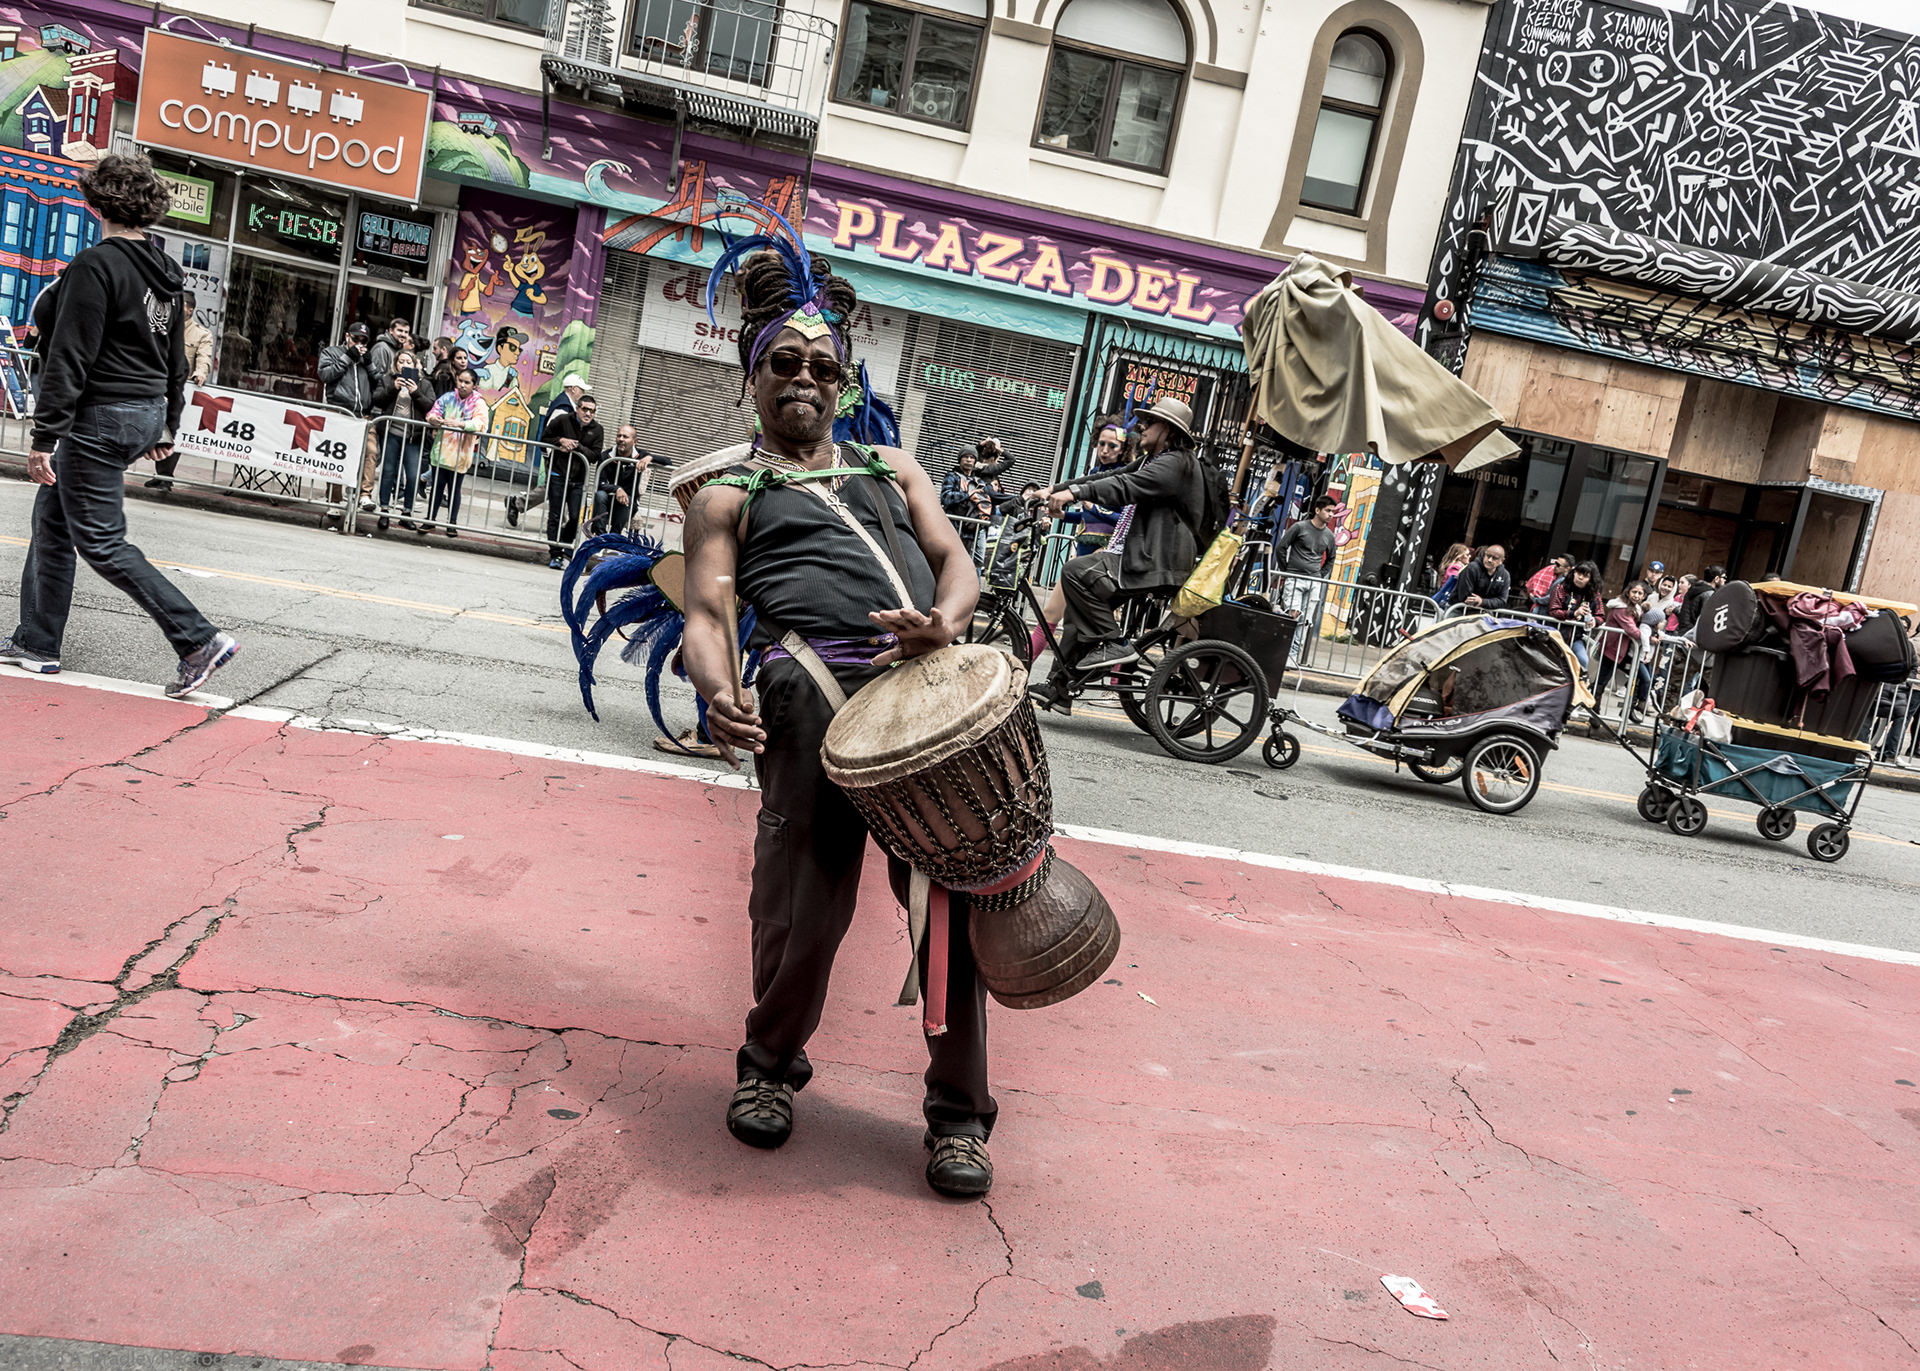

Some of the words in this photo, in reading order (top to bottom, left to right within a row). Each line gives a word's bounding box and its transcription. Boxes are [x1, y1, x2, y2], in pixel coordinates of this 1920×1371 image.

[1525, 10, 1576, 31] KEETON
[1601, 11, 1669, 40] STANDING
[1520, 23, 1572, 48] CUNNINGHAM
[1517, 38, 1551, 57] 2016
[159, 99, 404, 175] compupod
[164, 180, 206, 201] MPLE
[362, 213, 390, 237] CELL
[391, 220, 431, 246] PHONE
[391, 242, 427, 257] REPAIR
[367, 263, 402, 281] 2433
[831, 198, 1074, 298] PLAZA
[1085, 253, 1216, 325] DEL
[691, 339, 722, 355] flexi
[1125, 363, 1198, 393] MISSION
[222, 420, 255, 441] 48
[180, 442, 200, 451] AREA
[181, 432, 252, 454] TELEMUNDO
[315, 439, 347, 460] 48
[273, 461, 294, 469] AREA
[275, 451, 344, 473] TELEMUNDO
